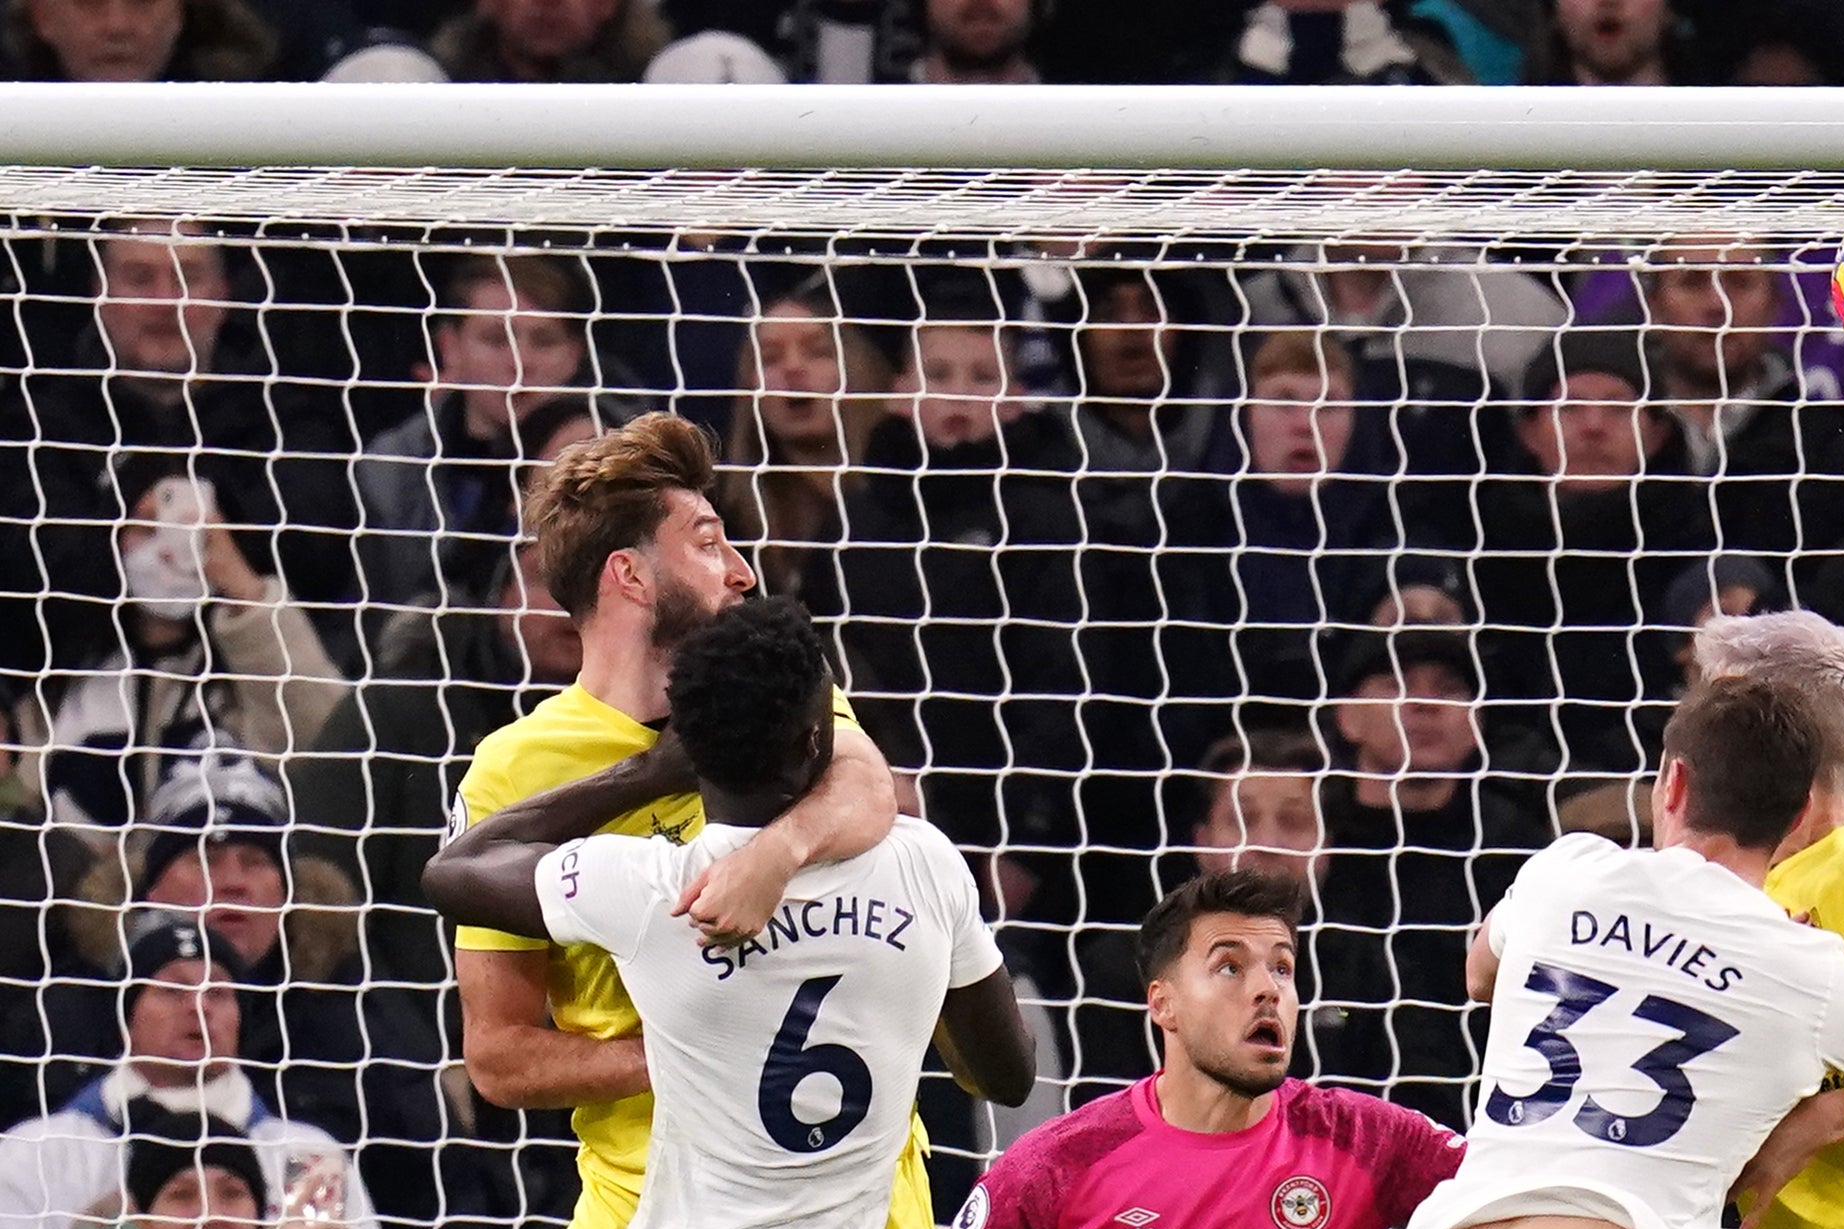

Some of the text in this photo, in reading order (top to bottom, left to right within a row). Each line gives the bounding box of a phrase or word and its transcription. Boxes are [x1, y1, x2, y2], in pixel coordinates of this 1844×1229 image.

[702, 897, 914, 981] SANCHEZ
[1571, 910, 1743, 992] DAVIES
[758, 973, 874, 1154] 6
[1485, 961, 1740, 1147] 33
